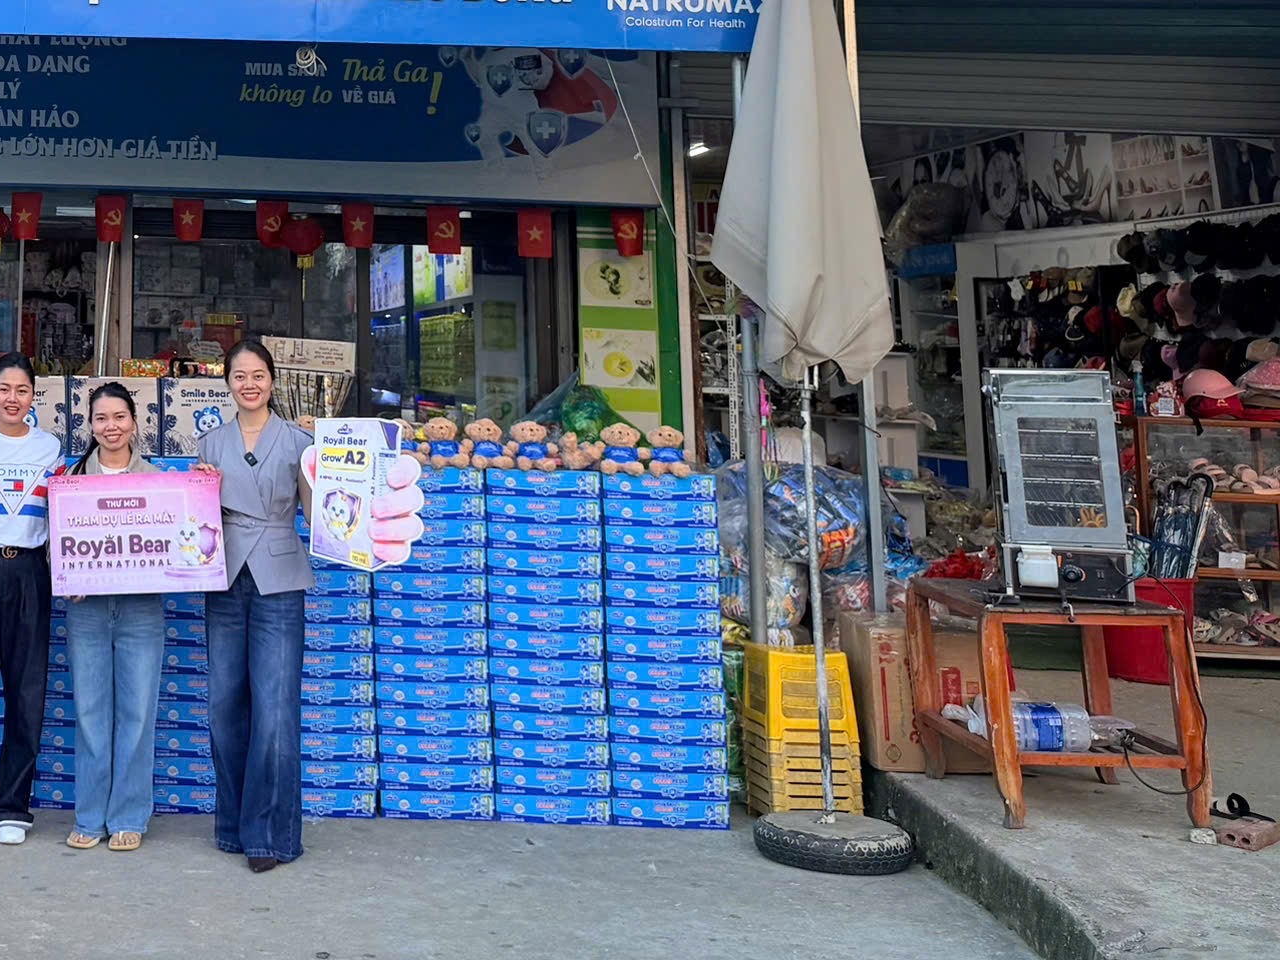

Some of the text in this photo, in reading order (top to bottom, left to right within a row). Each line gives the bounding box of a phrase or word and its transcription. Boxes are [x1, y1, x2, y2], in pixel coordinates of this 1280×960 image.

[626, 17, 746, 28] Colostrum For Health
[27, 55, 90, 76] DẠNG
[245, 58, 429, 82] MUA Thả Ga
[240, 84, 396, 107] không lo VỀ GIÁ
[30, 105, 80, 128] HẢO
[120, 135, 160, 159] GIÁ
[181, 389, 230, 398] Smile Bear
[323, 436, 367, 446] Royal Bear
[344, 451, 365, 465] A2
[106, 500, 122, 508] THƯ
[68, 516, 99, 527] THAM
[102, 515, 119, 528] DỰ
[136, 514, 151, 524] RA
[61, 534, 171, 559] Royal Bear
[62, 559, 172, 569] INTERNATIONAL
